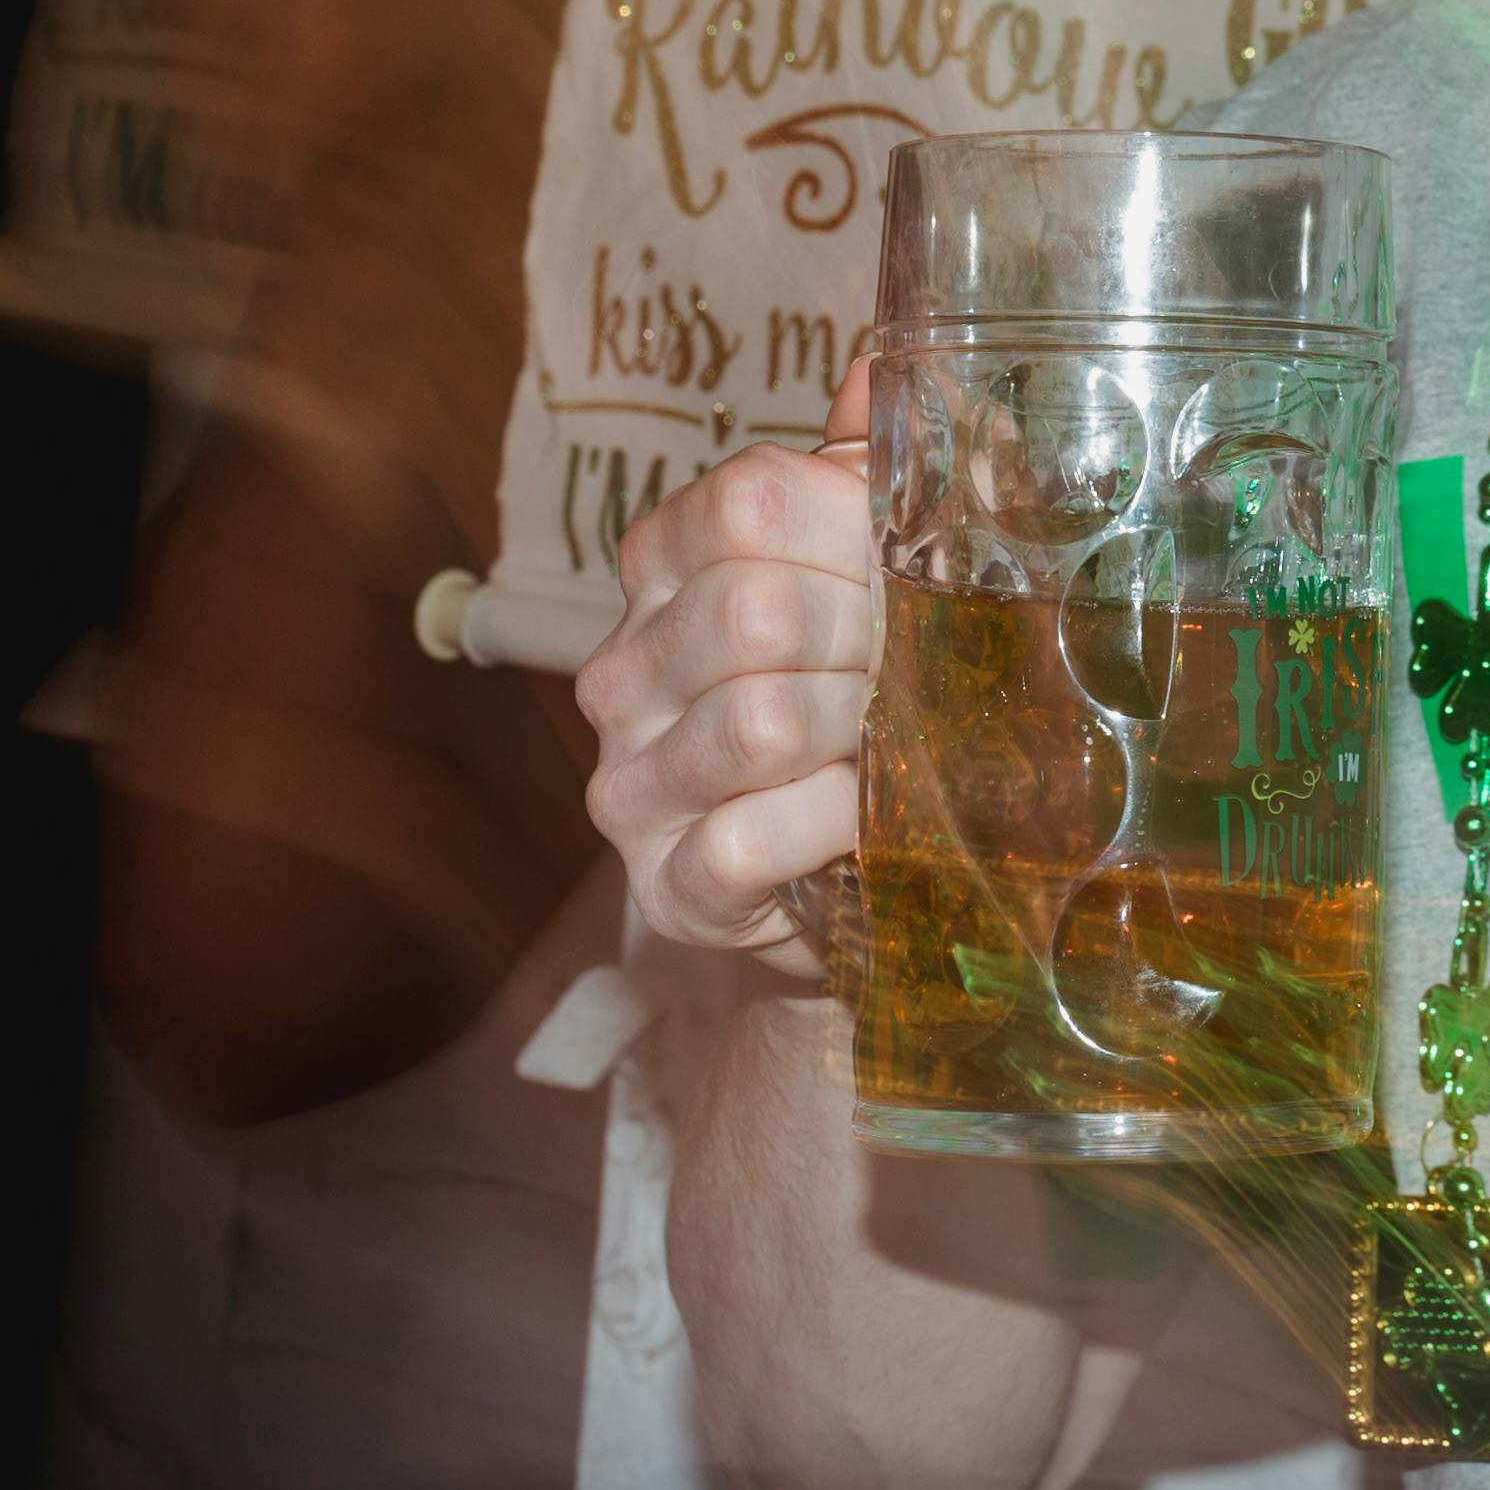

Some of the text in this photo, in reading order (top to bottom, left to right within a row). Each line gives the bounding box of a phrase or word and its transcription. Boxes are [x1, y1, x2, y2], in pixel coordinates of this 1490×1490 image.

[589, 246, 742, 392] kiss
[1249, 574, 1351, 620] I'M NOT
[1337, 752, 1360, 783] I'M
